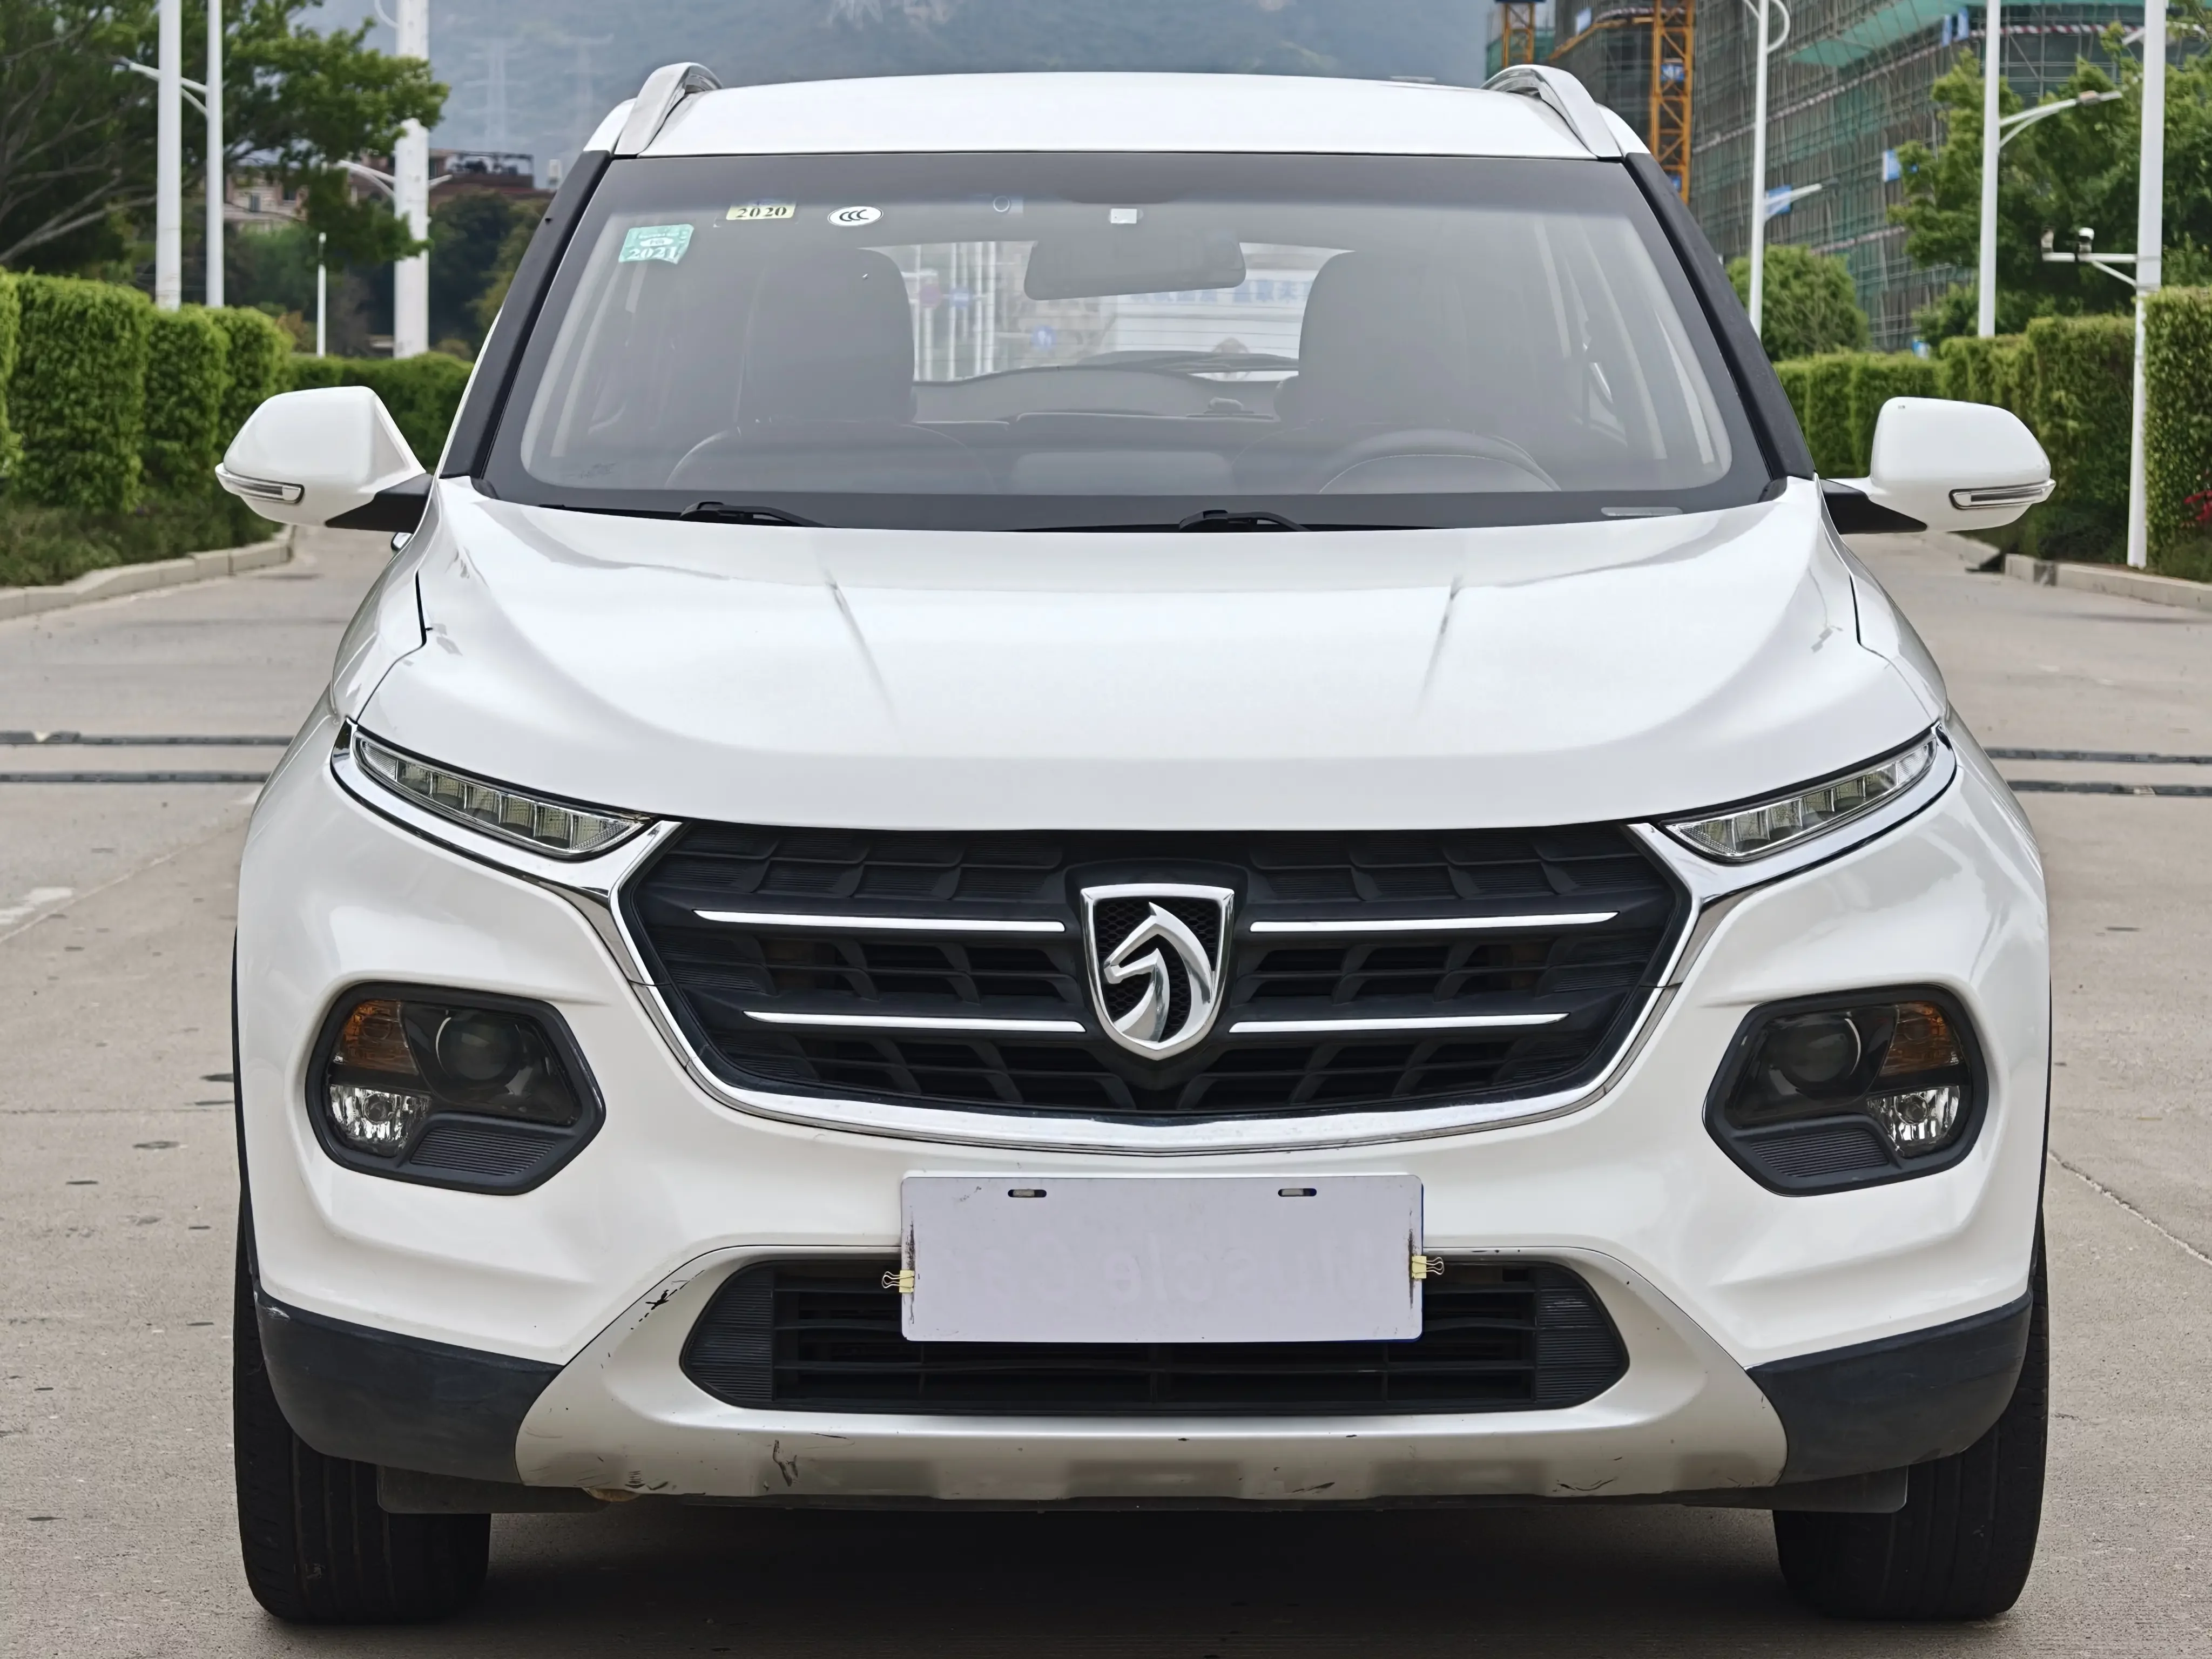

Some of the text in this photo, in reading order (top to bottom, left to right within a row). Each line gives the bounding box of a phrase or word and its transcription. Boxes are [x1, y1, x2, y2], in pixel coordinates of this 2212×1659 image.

[736, 207, 787, 218] 2020
[839, 210, 869, 221] CCC
[627, 247, 677, 259] 2021
